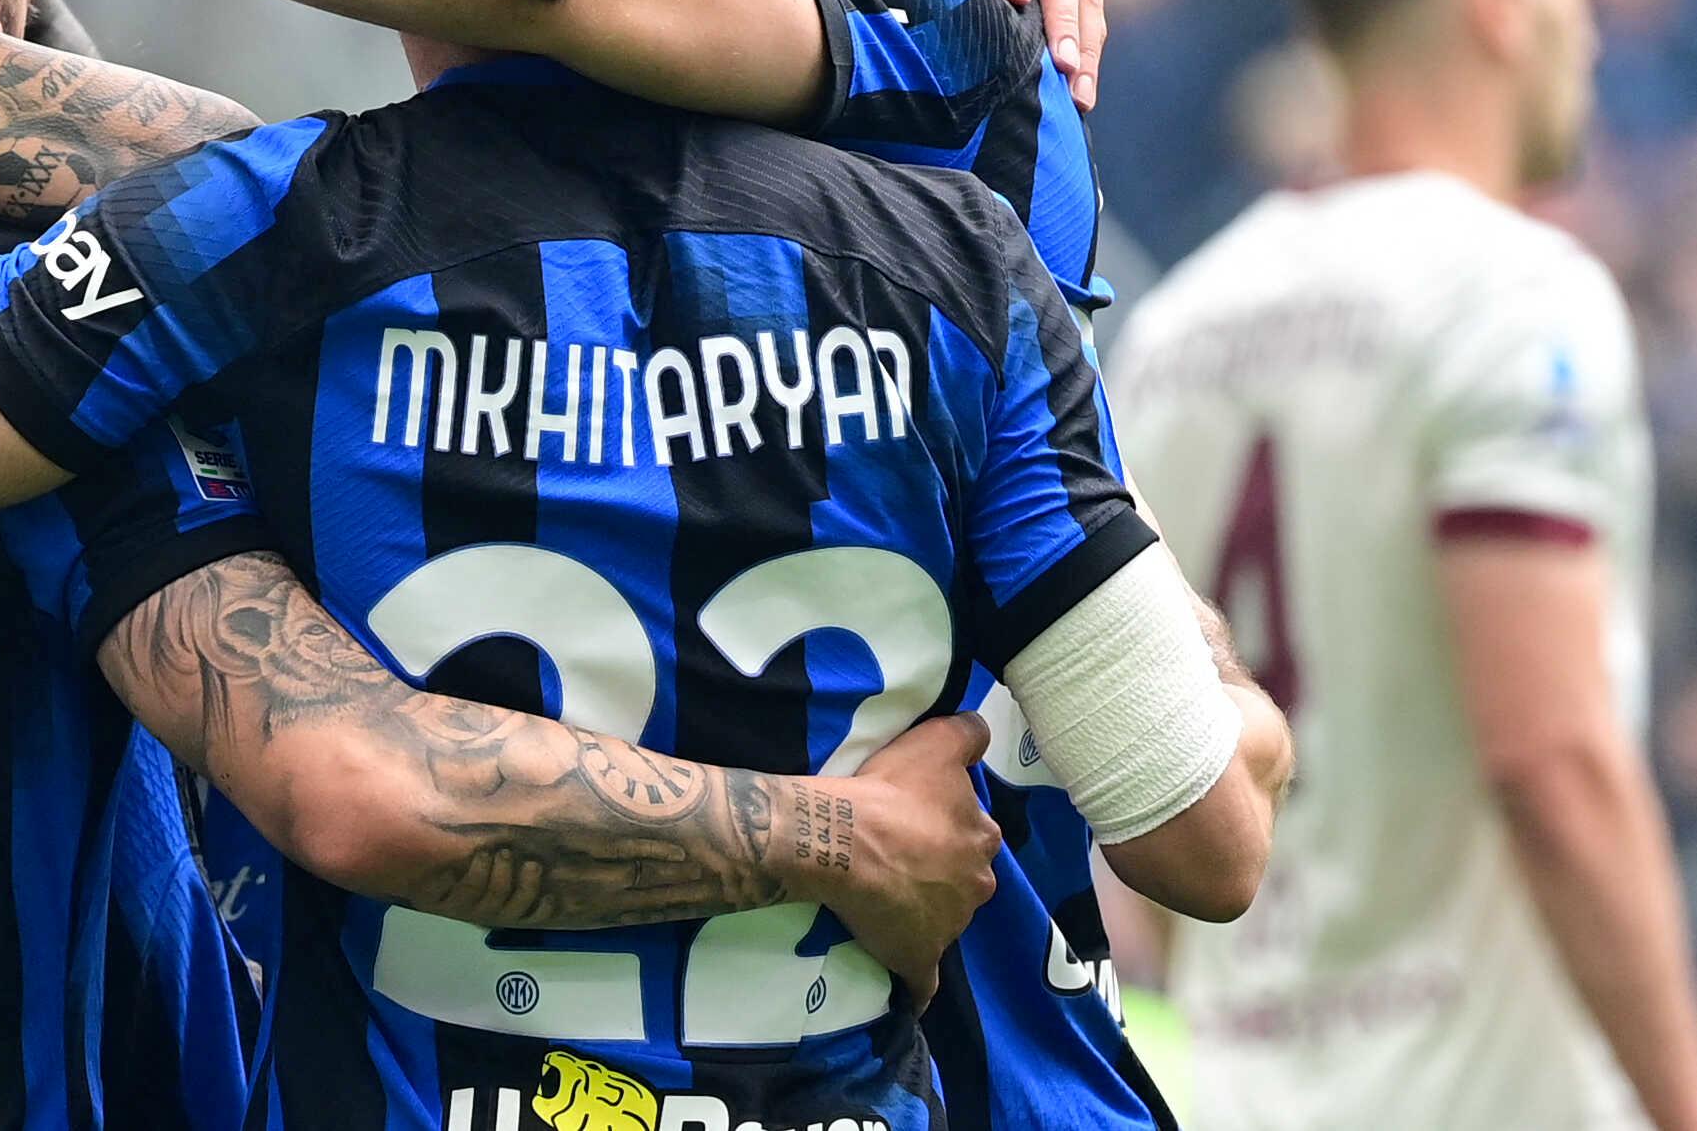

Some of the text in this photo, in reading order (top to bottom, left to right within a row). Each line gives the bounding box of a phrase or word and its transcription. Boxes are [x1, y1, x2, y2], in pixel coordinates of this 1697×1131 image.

[372, 326, 912, 464] MKHITARYAN
[366, 543, 953, 1047] 22
[834, 796, 853, 871] 20.11.2023
